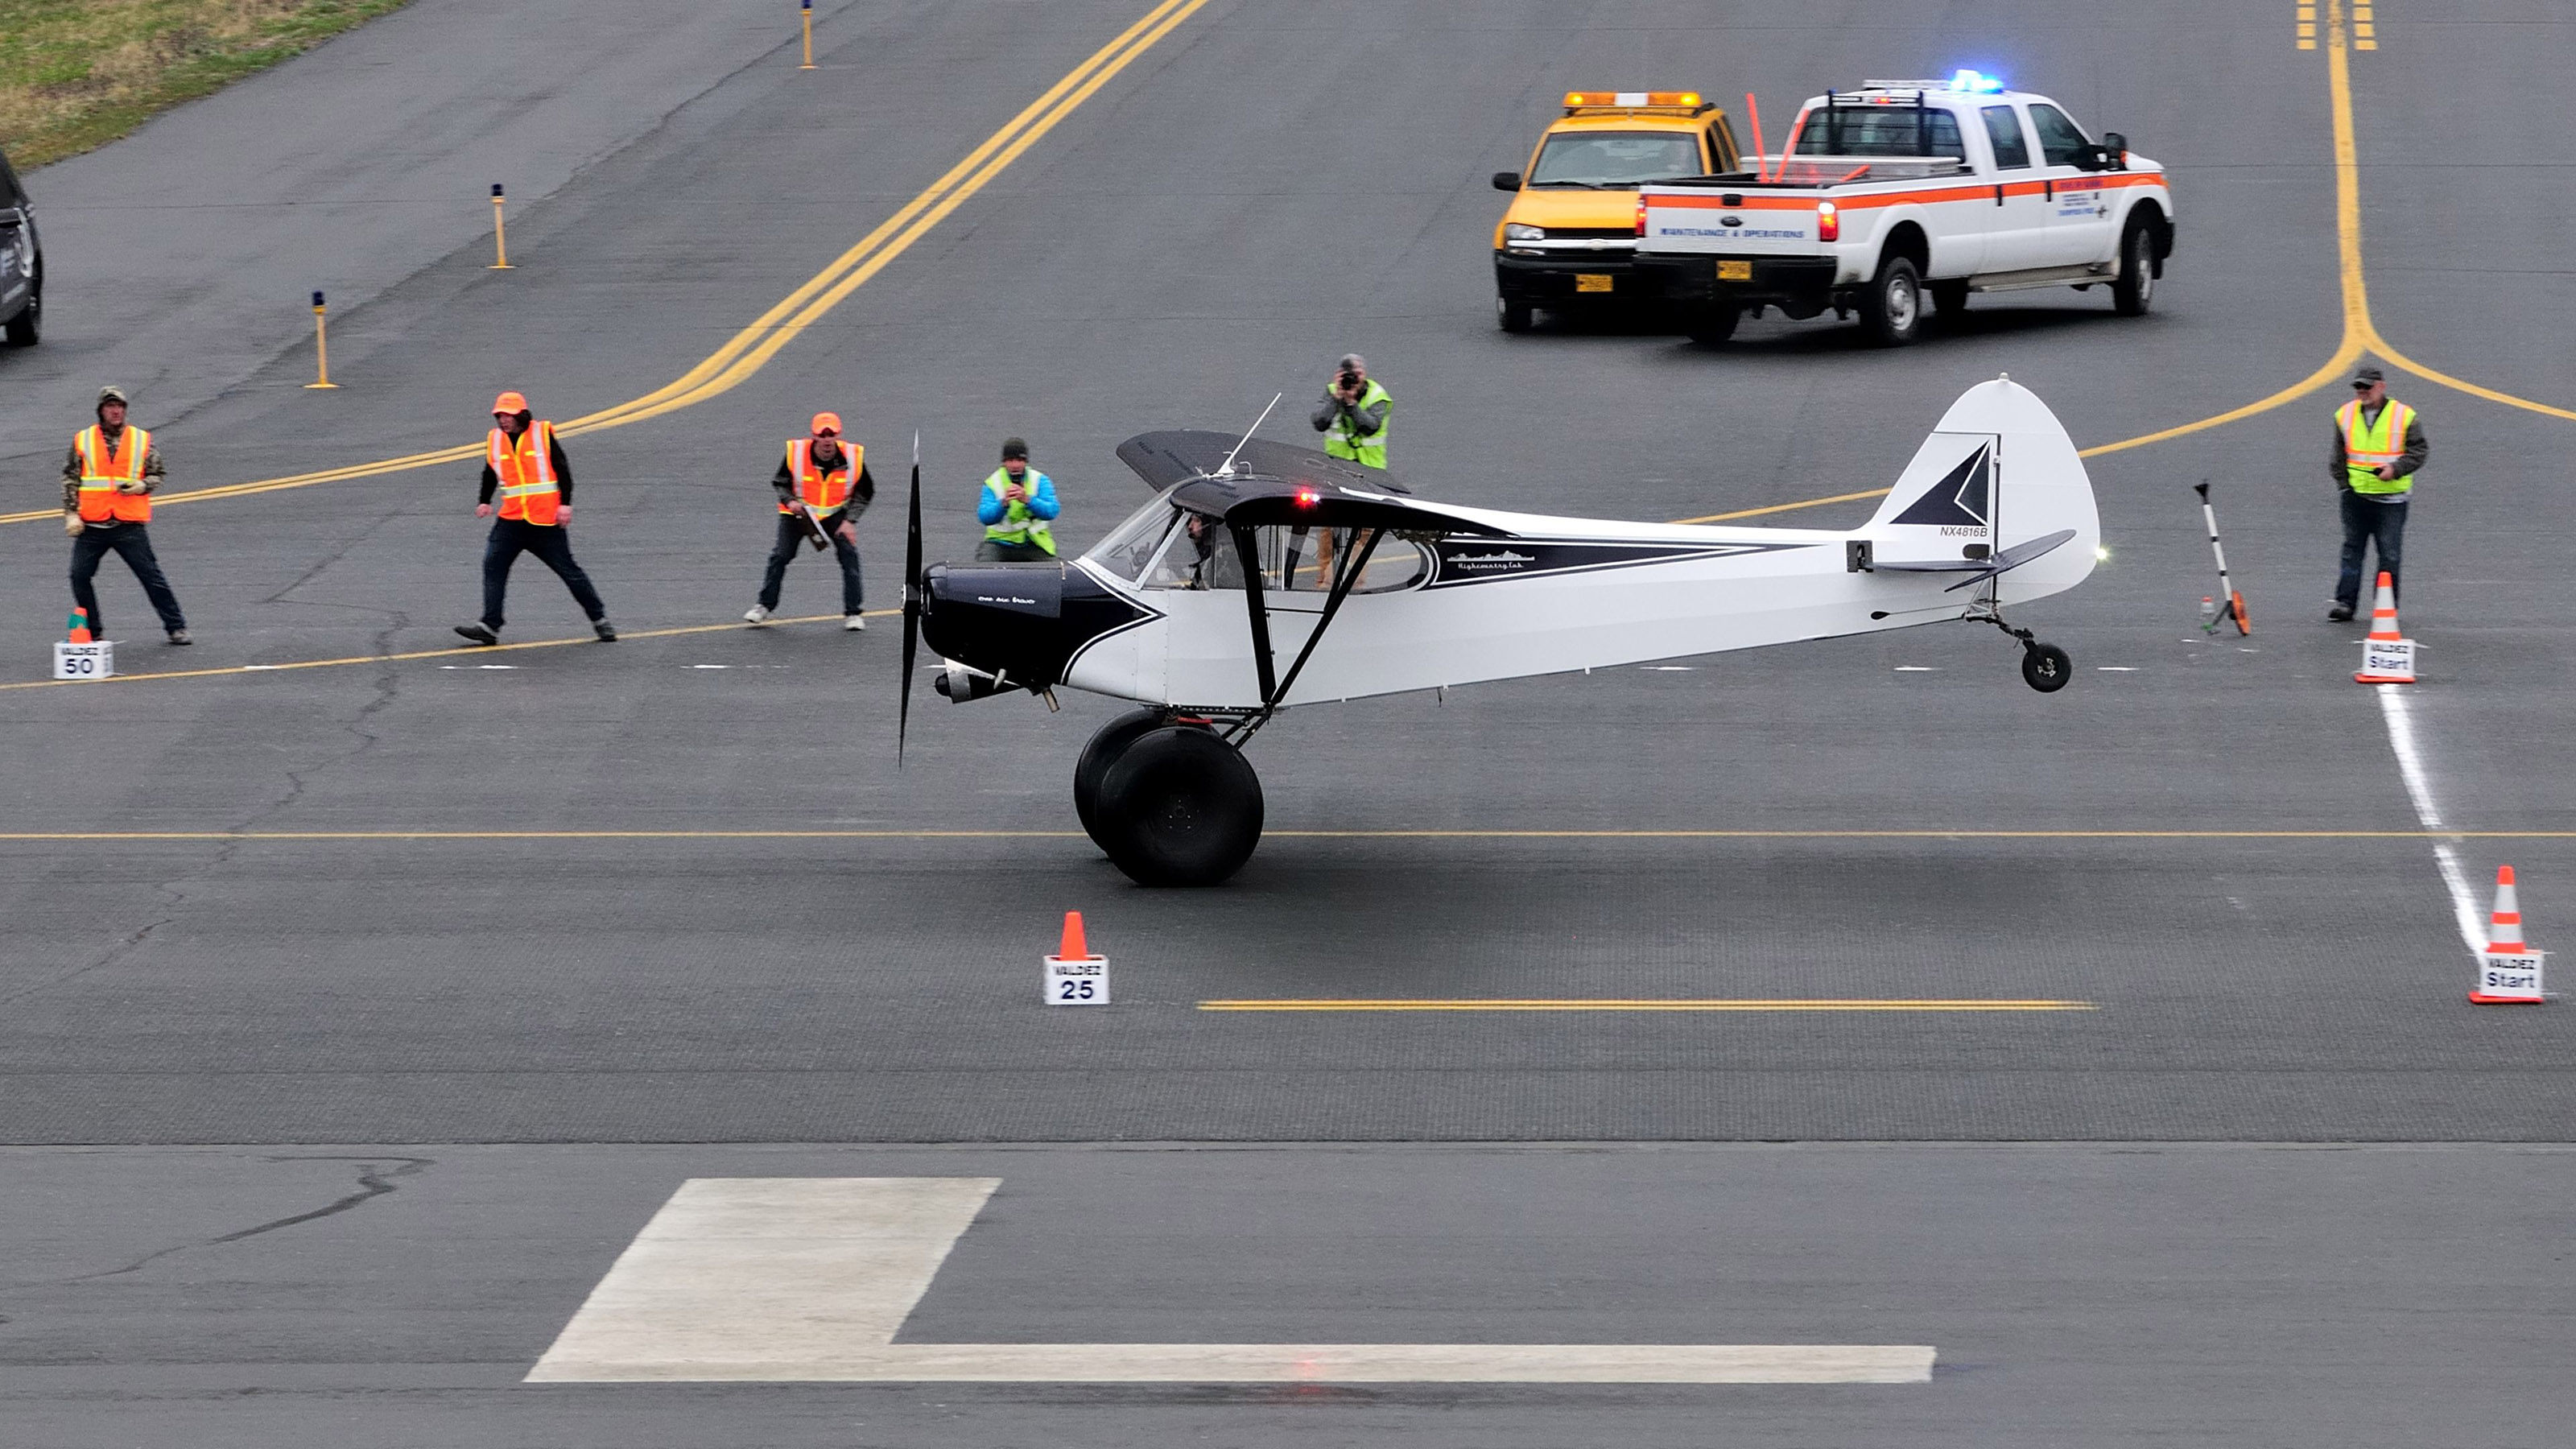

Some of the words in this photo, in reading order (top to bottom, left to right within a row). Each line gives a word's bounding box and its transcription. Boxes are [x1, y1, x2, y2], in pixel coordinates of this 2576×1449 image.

[1940, 526, 1988, 537] NX4816B
[65, 658, 93, 674] 50
[2370, 656, 2408, 670] Start
[2488, 972, 2535, 988] Start
[1061, 980, 1093, 999] 25
